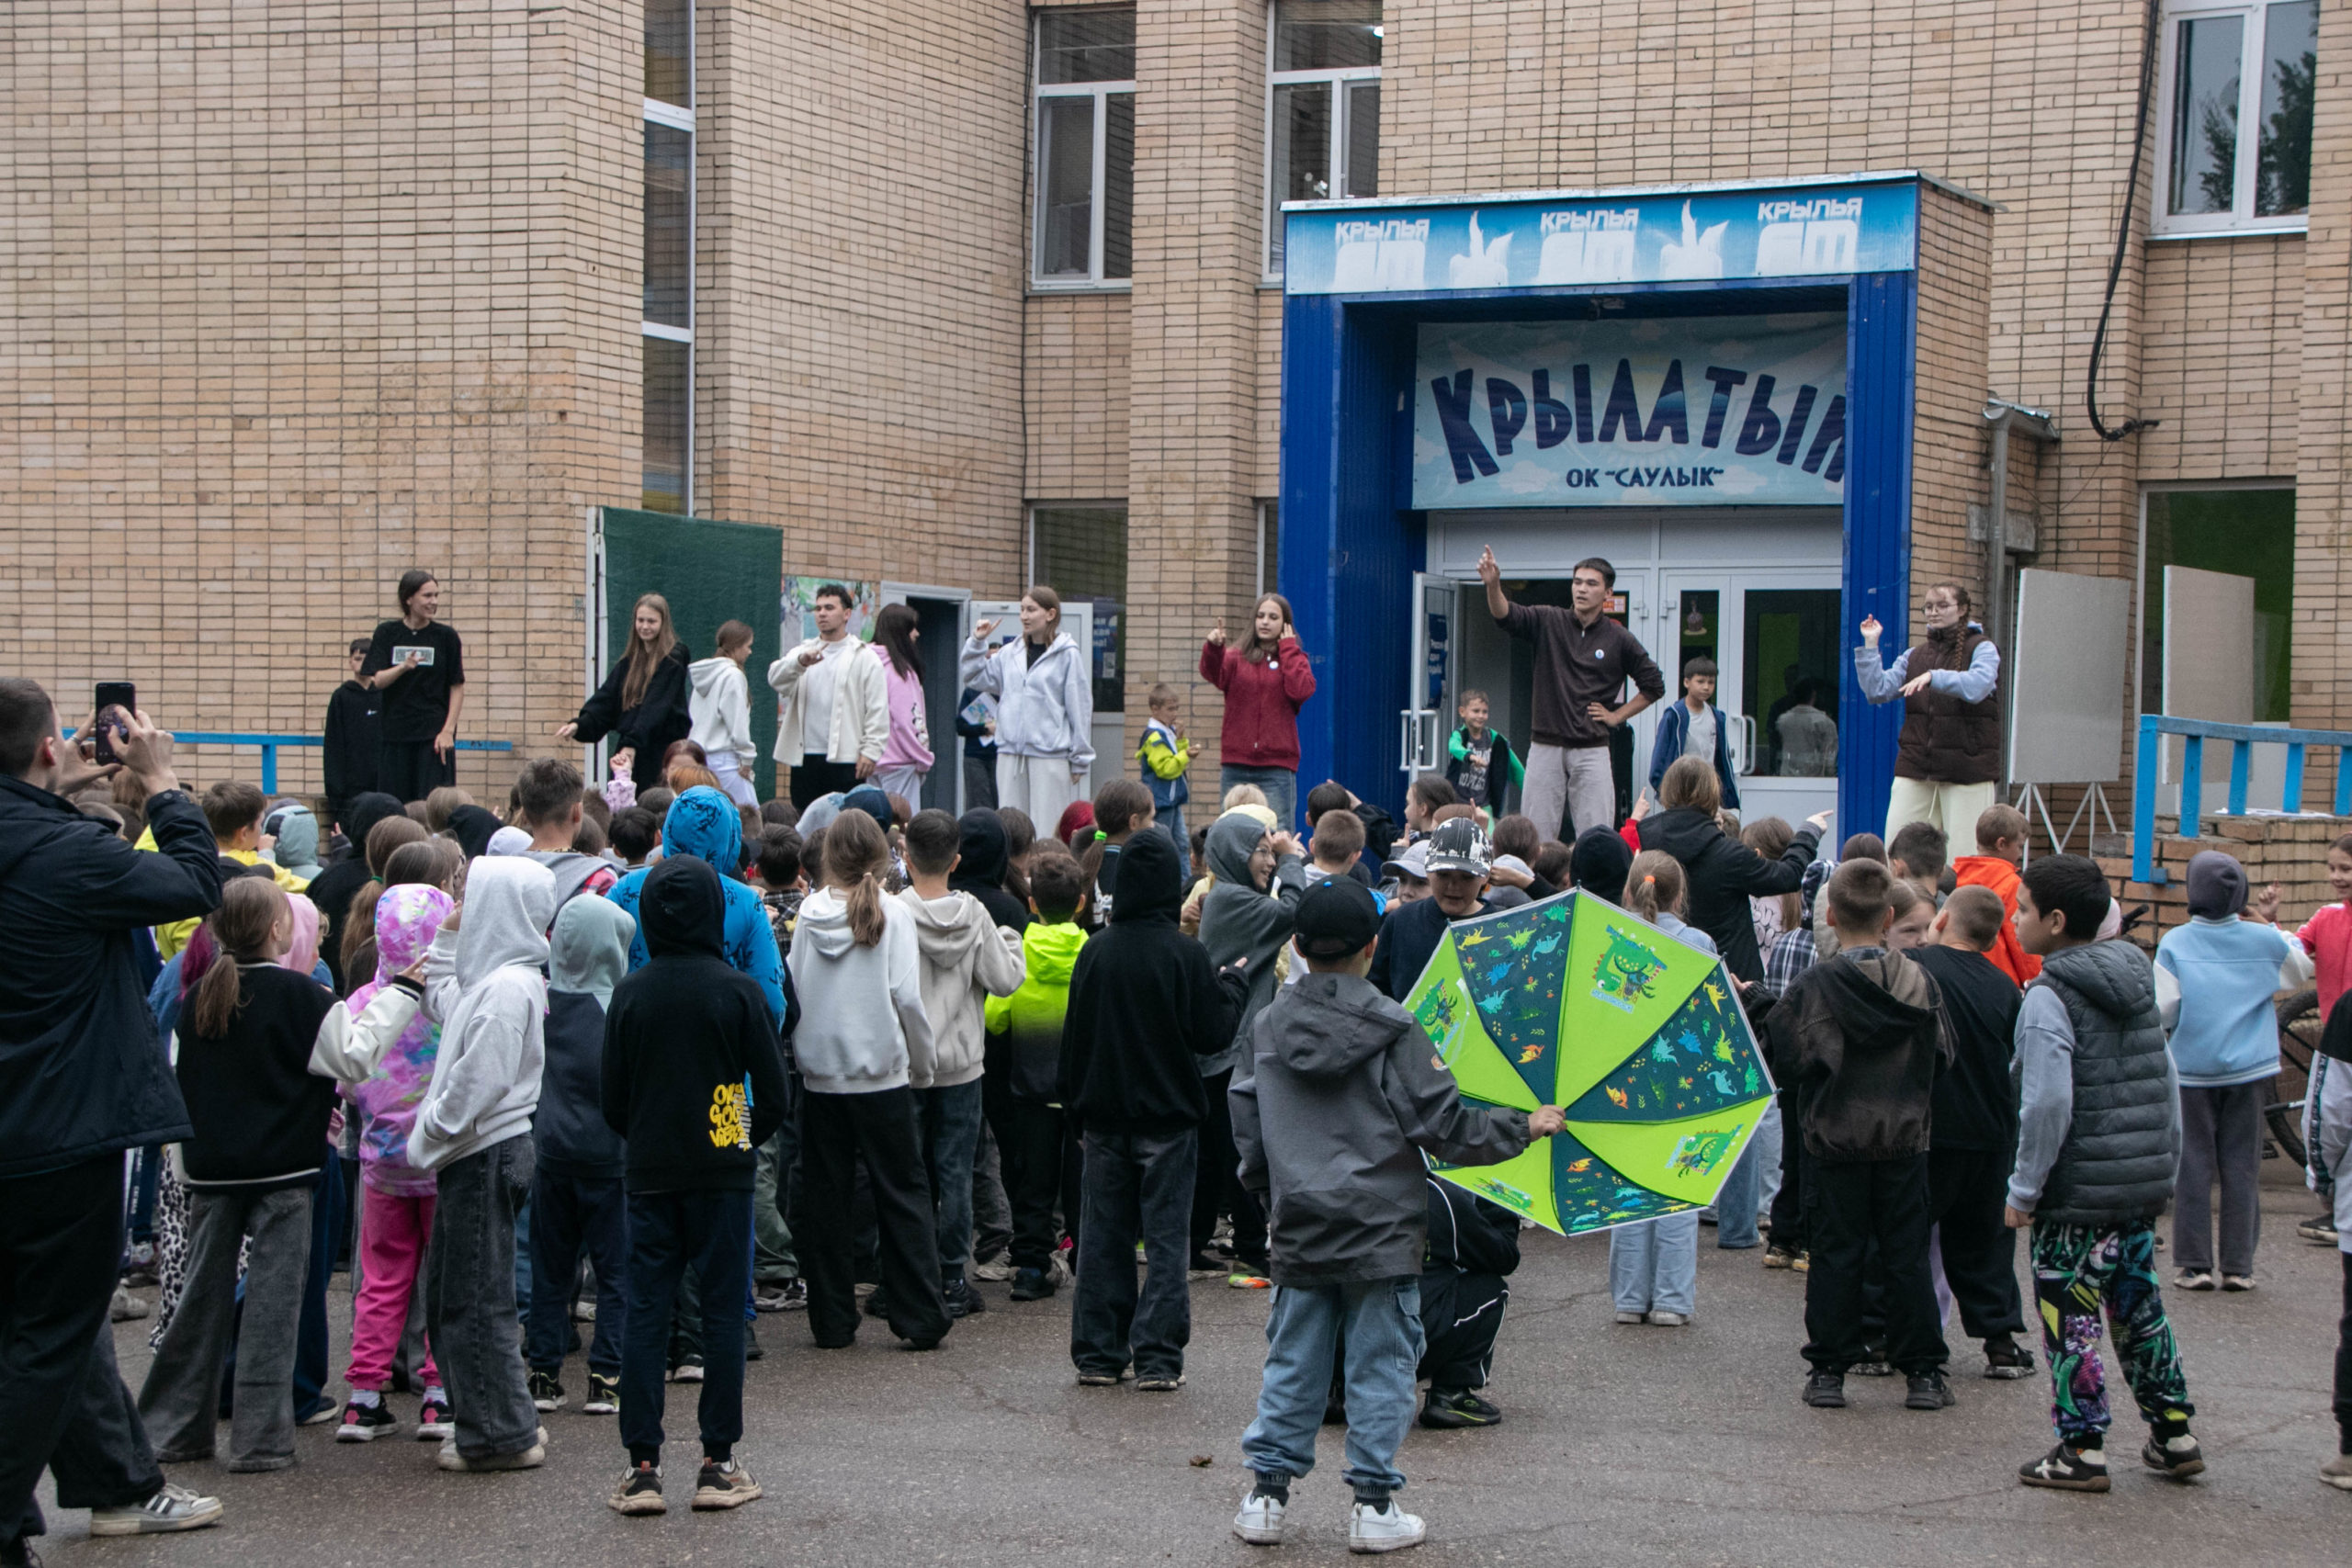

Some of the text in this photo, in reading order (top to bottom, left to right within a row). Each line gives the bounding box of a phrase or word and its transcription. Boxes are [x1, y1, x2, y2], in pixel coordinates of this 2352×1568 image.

[1540, 208, 1640, 233] КРЫЛЬЯ
[1758, 197, 1863, 221] КРЫЛЬЯ
[1335, 219, 1430, 244] КРЫЛЬЯ
[1566, 468, 1600, 488] ОК
